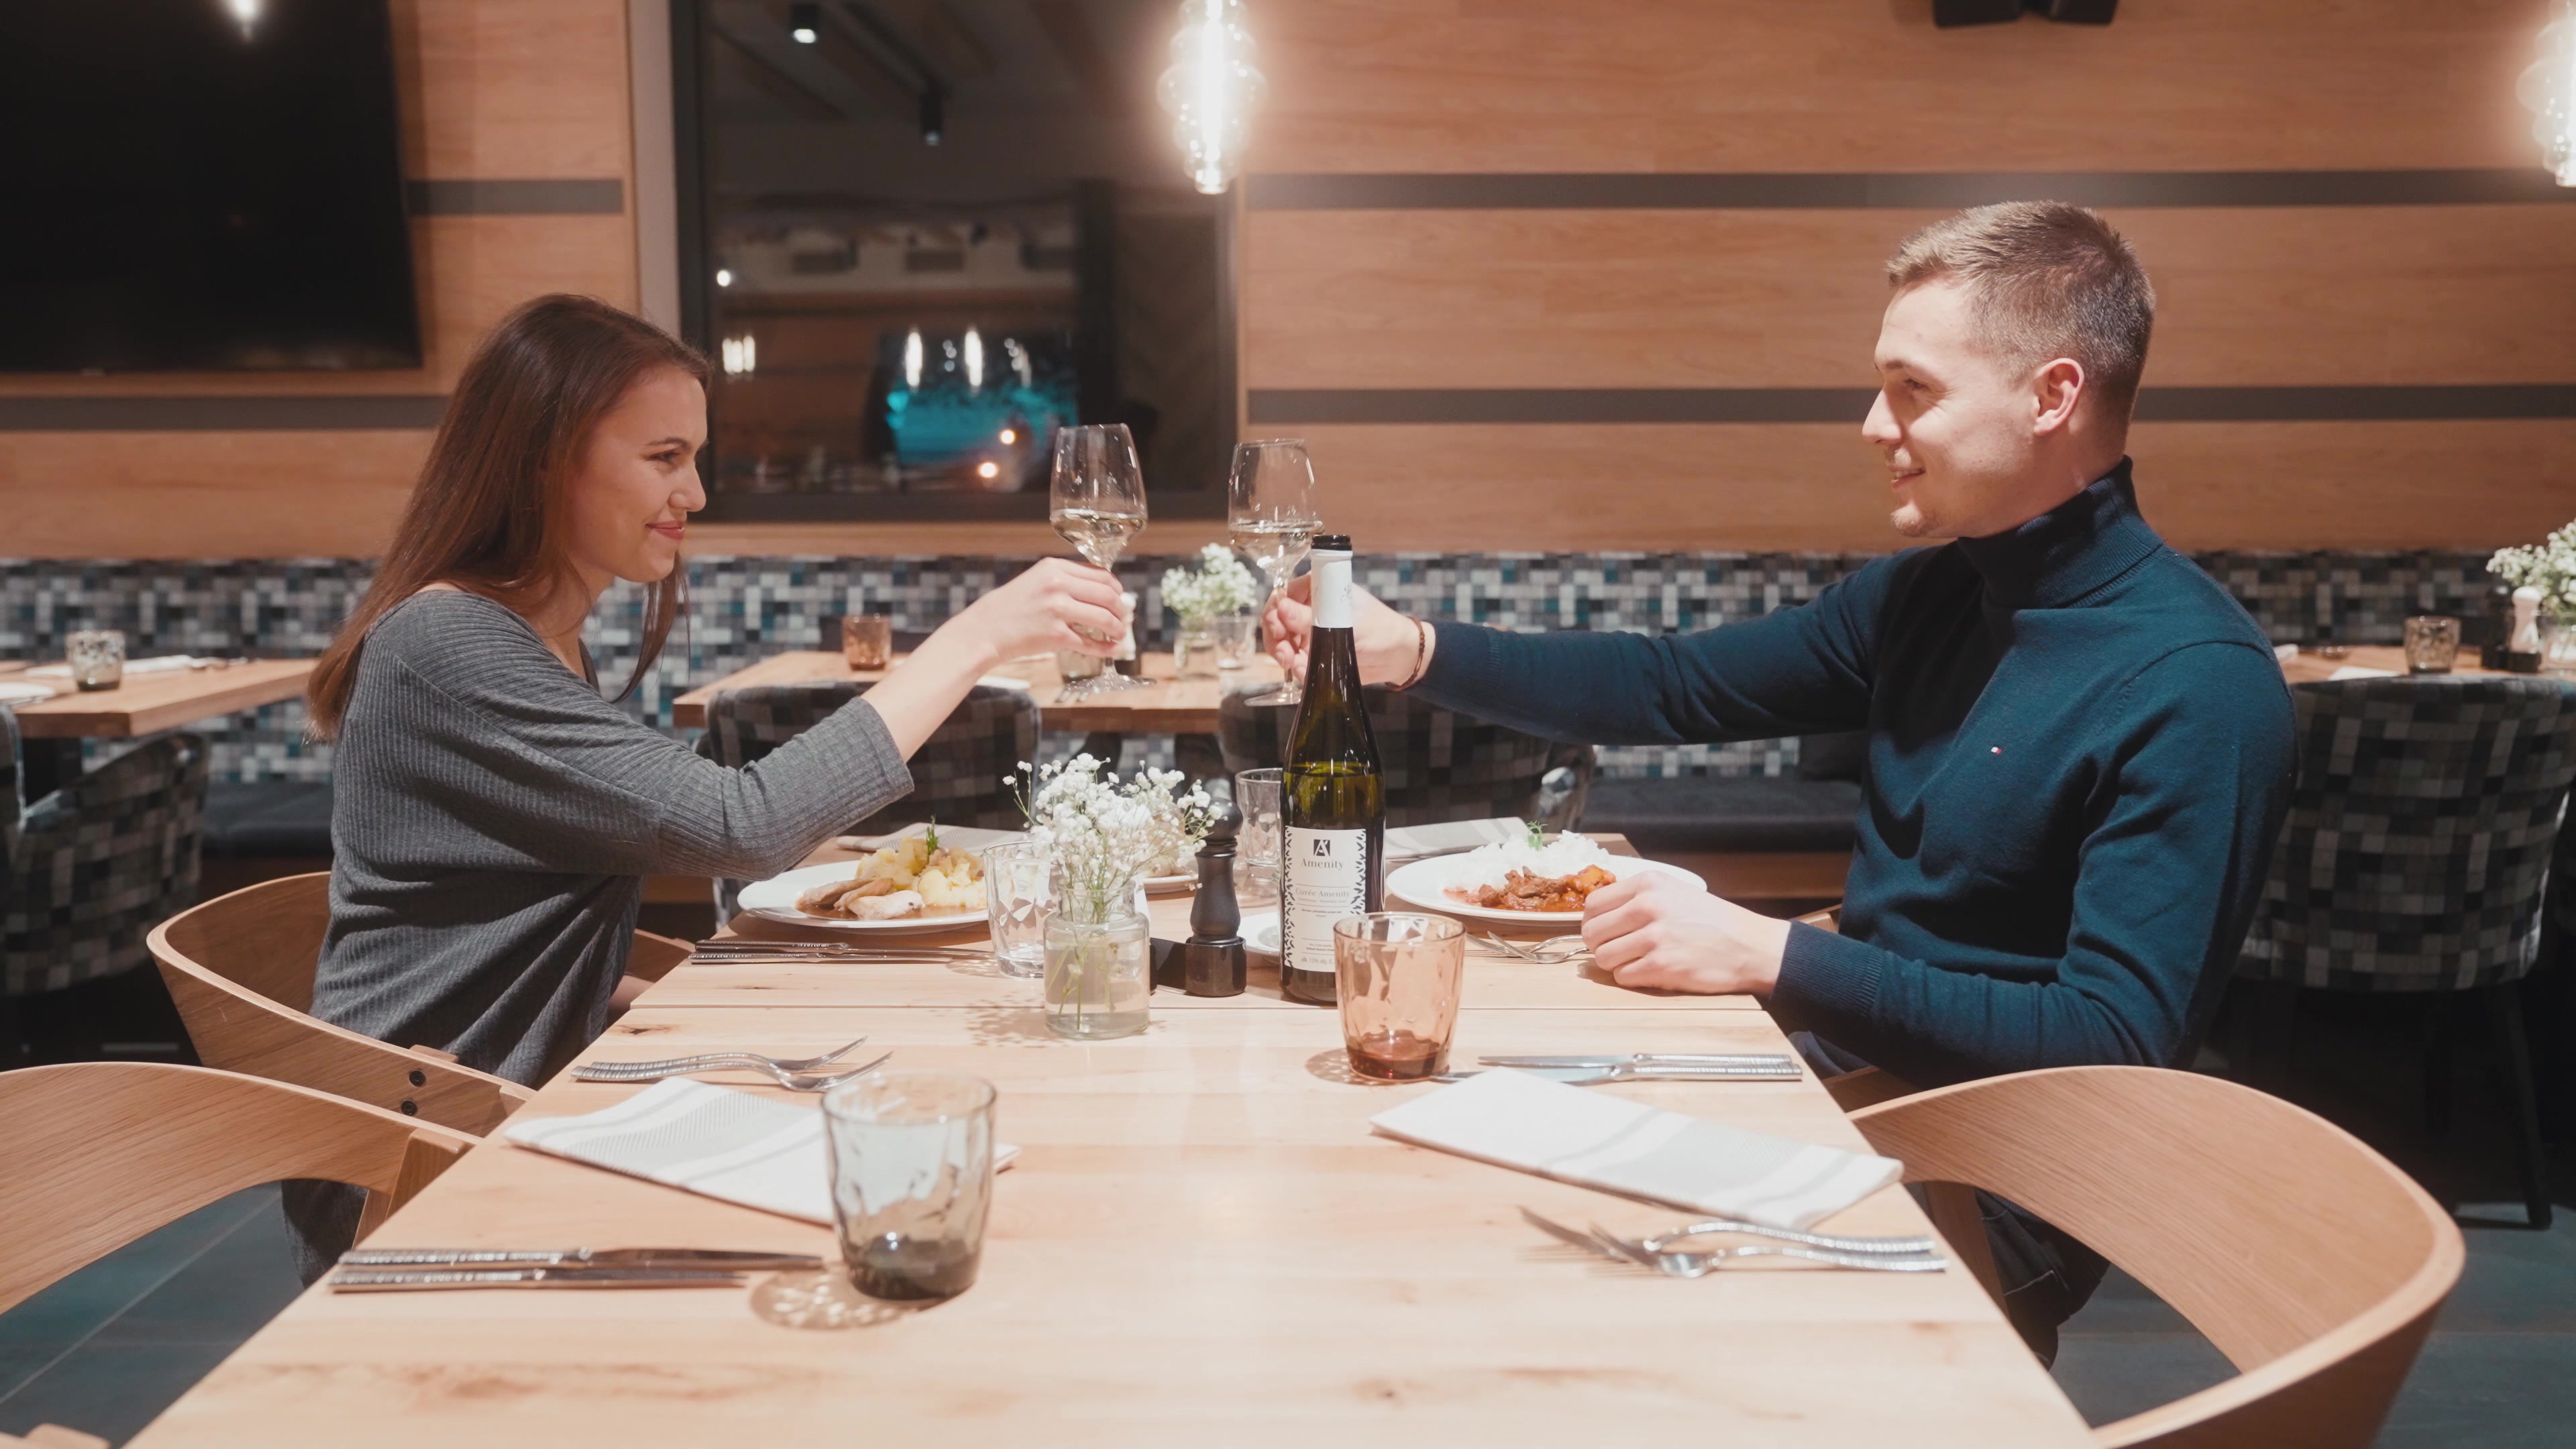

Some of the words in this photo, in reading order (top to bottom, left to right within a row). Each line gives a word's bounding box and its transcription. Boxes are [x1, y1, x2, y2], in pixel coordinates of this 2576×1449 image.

[1301, 858, 1344, 871] Amenity
[1295, 887, 1317, 897] Cuvée
[1318, 890, 1350, 900] Amenity
